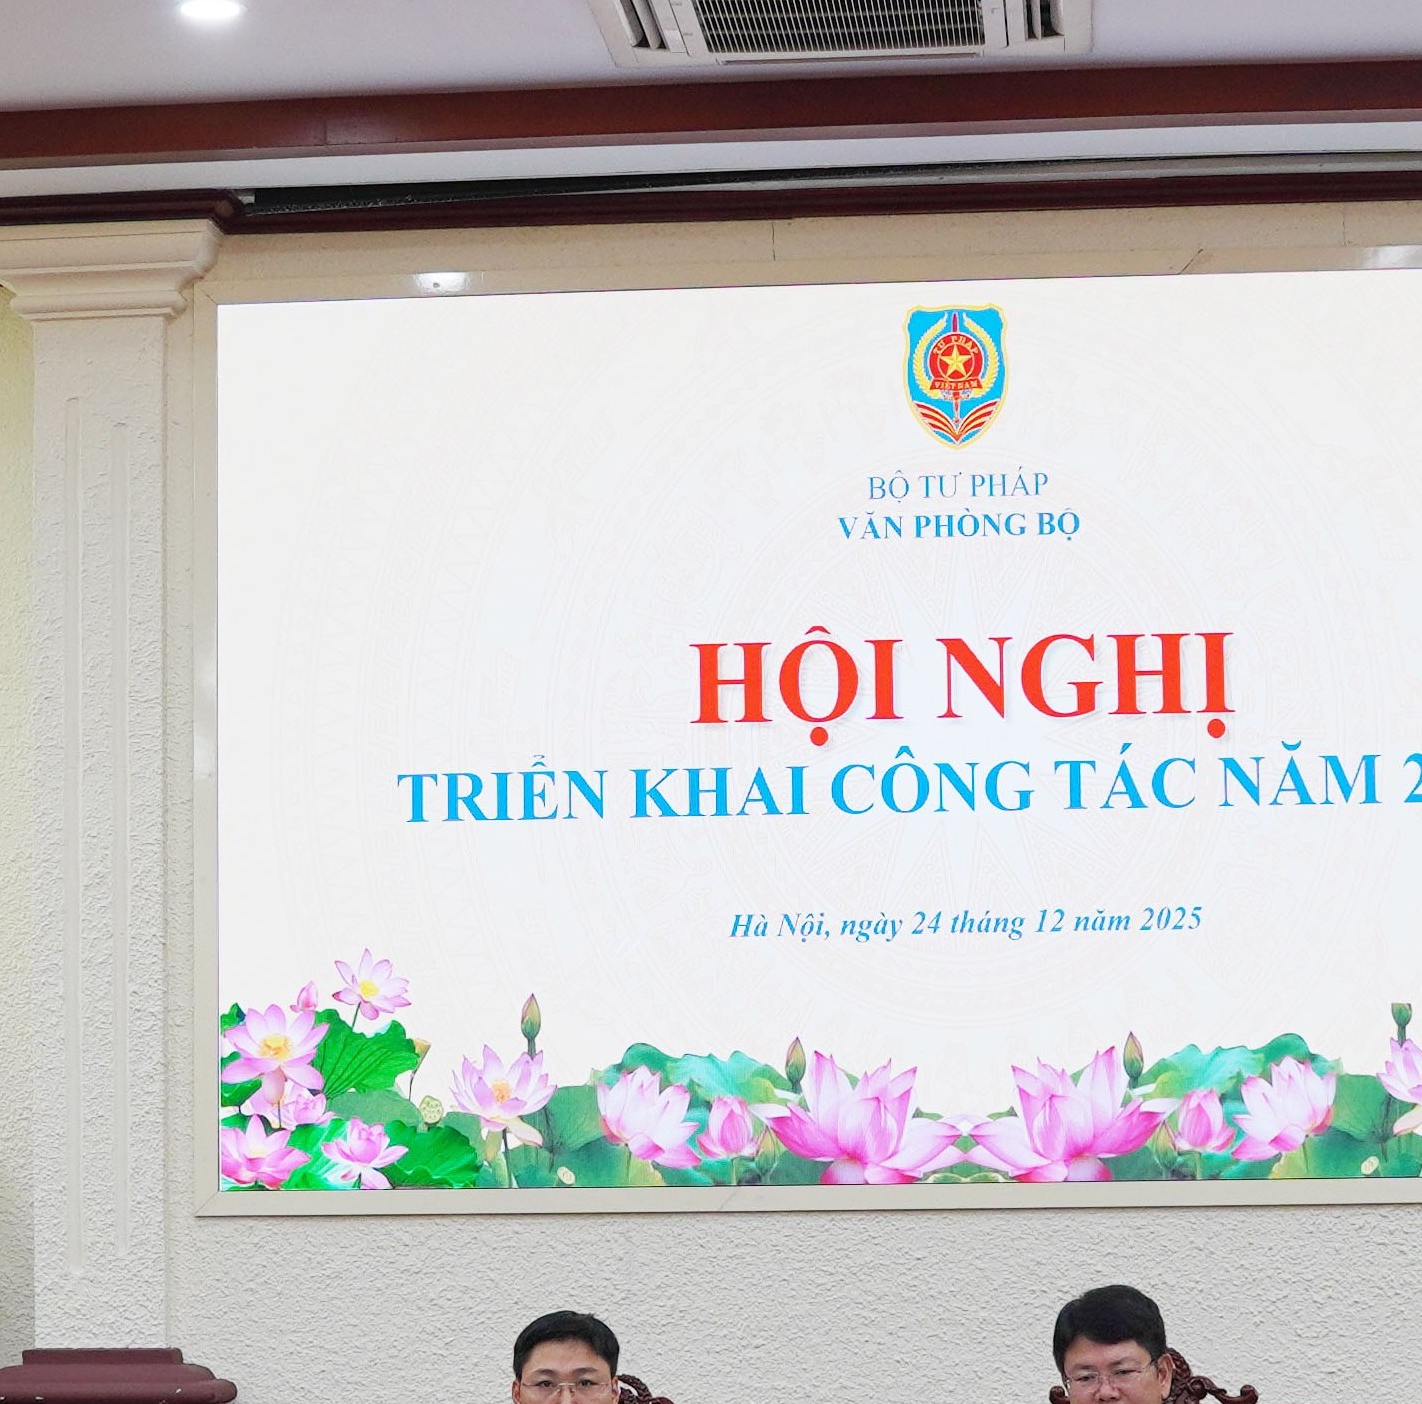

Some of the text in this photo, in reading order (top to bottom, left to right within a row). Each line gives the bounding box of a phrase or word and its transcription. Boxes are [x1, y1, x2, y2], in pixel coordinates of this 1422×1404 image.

[868, 466, 1049, 503] BỘ TƯ PHÁP
[838, 508, 1080, 541] VĂN PHÒNG BỘ
[690, 626, 1234, 748] HỘI NGHỊ
[397, 752, 607, 823] TRIỂN
[632, 766, 808, 818] KHAI
[830, 744, 1035, 815] CÔNG
[1053, 742, 1196, 809] TÁC
[1219, 740, 1379, 807] NĂM
[730, 905, 1203, 943] Hà Nội, ngày 24 tháng 12 năm 2025
